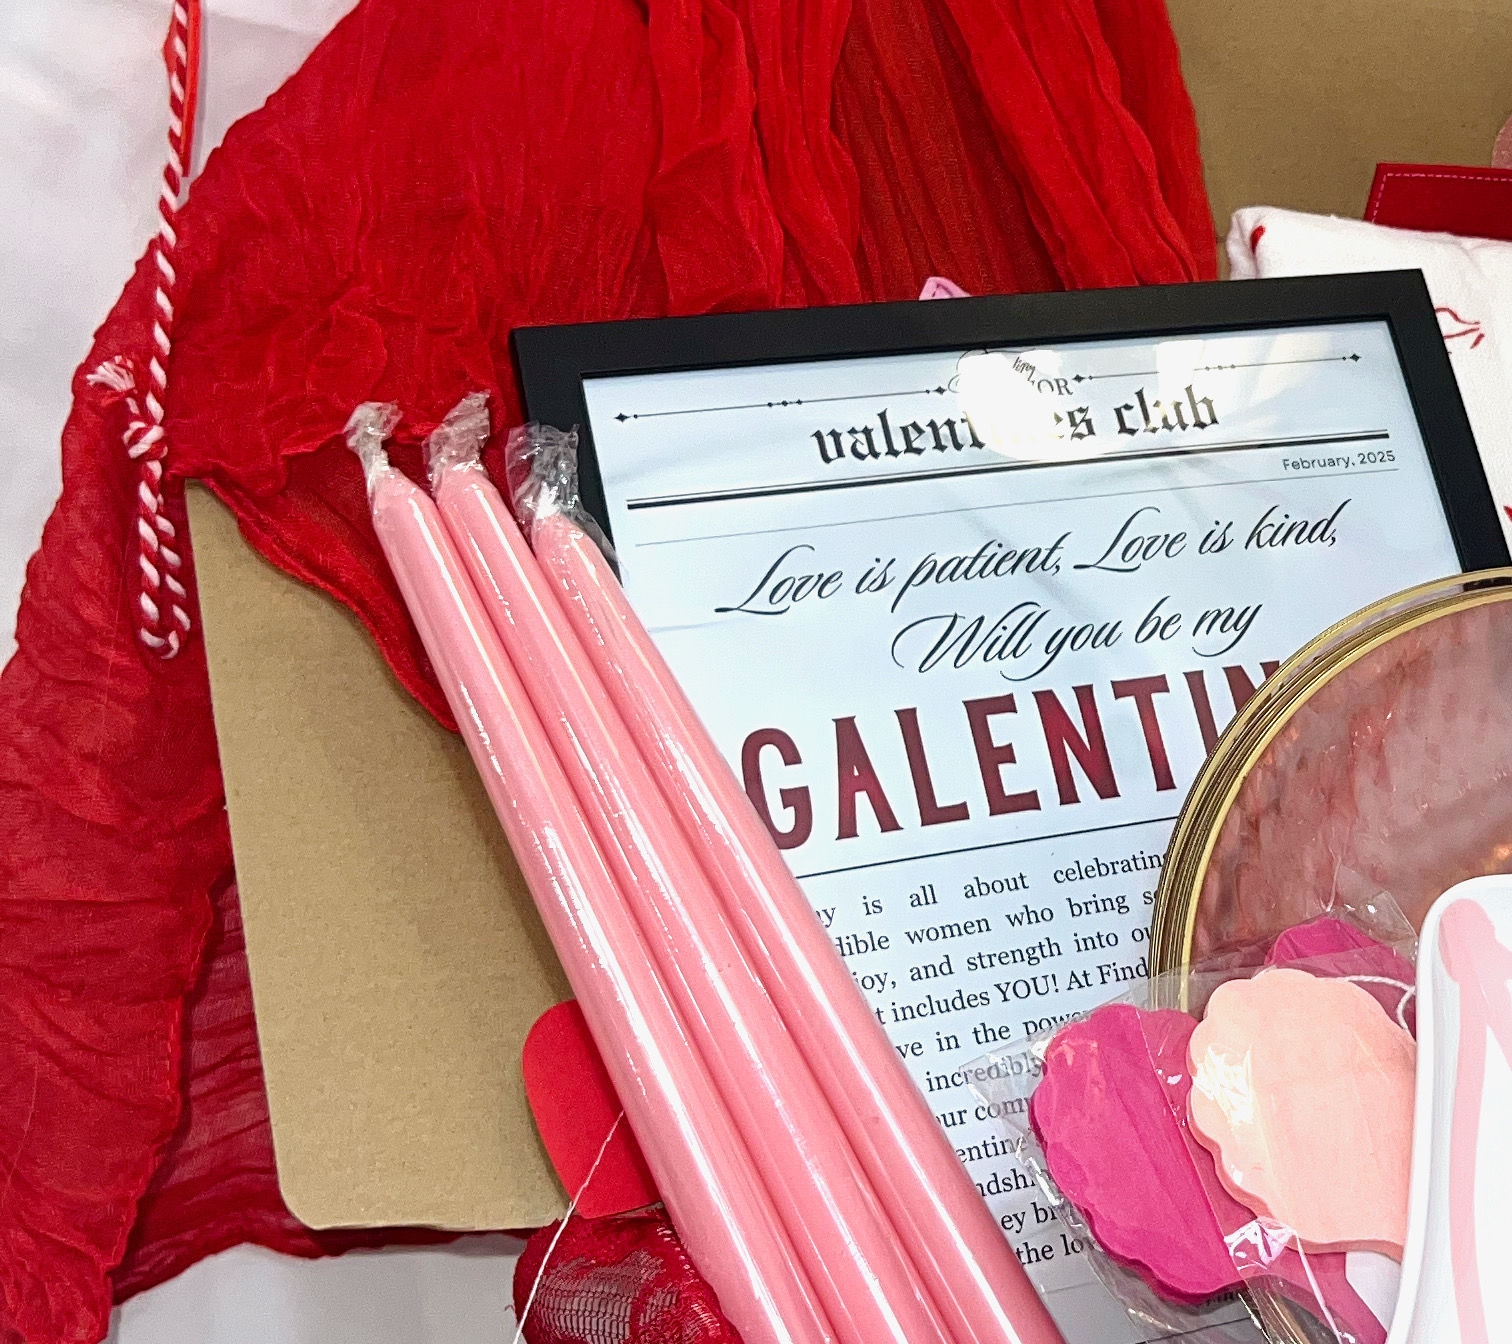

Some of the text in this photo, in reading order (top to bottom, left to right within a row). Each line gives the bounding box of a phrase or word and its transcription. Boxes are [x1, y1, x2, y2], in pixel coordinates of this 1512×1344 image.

[1114, 384, 1220, 438] club
[1357, 450, 1396, 465] 2025
[715, 498, 1352, 616] Love is patient, Love is kind,
[891, 595, 1263, 682] Will you be my
[862, 895, 884, 916] is
[909, 884, 938, 909] all
[963, 871, 1030, 900] about
[1053, 850, 1167, 885] celebratin
[905, 915, 992, 945] women
[1005, 905, 1054, 929] who
[1066, 888, 1131, 919] bring
[909, 955, 955, 984] and
[966, 937, 1063, 973] strength
[1073, 926, 1120, 954] into
[891, 989, 990, 1026] includes
[994, 973, 1061, 1005] YOU!
[1065, 967, 1096, 993] At
[1098, 956, 1150, 987] Find
[936, 1026, 961, 1053] in
[972, 1022, 1011, 1047] the
[925, 1052, 1043, 1093] incredibly
